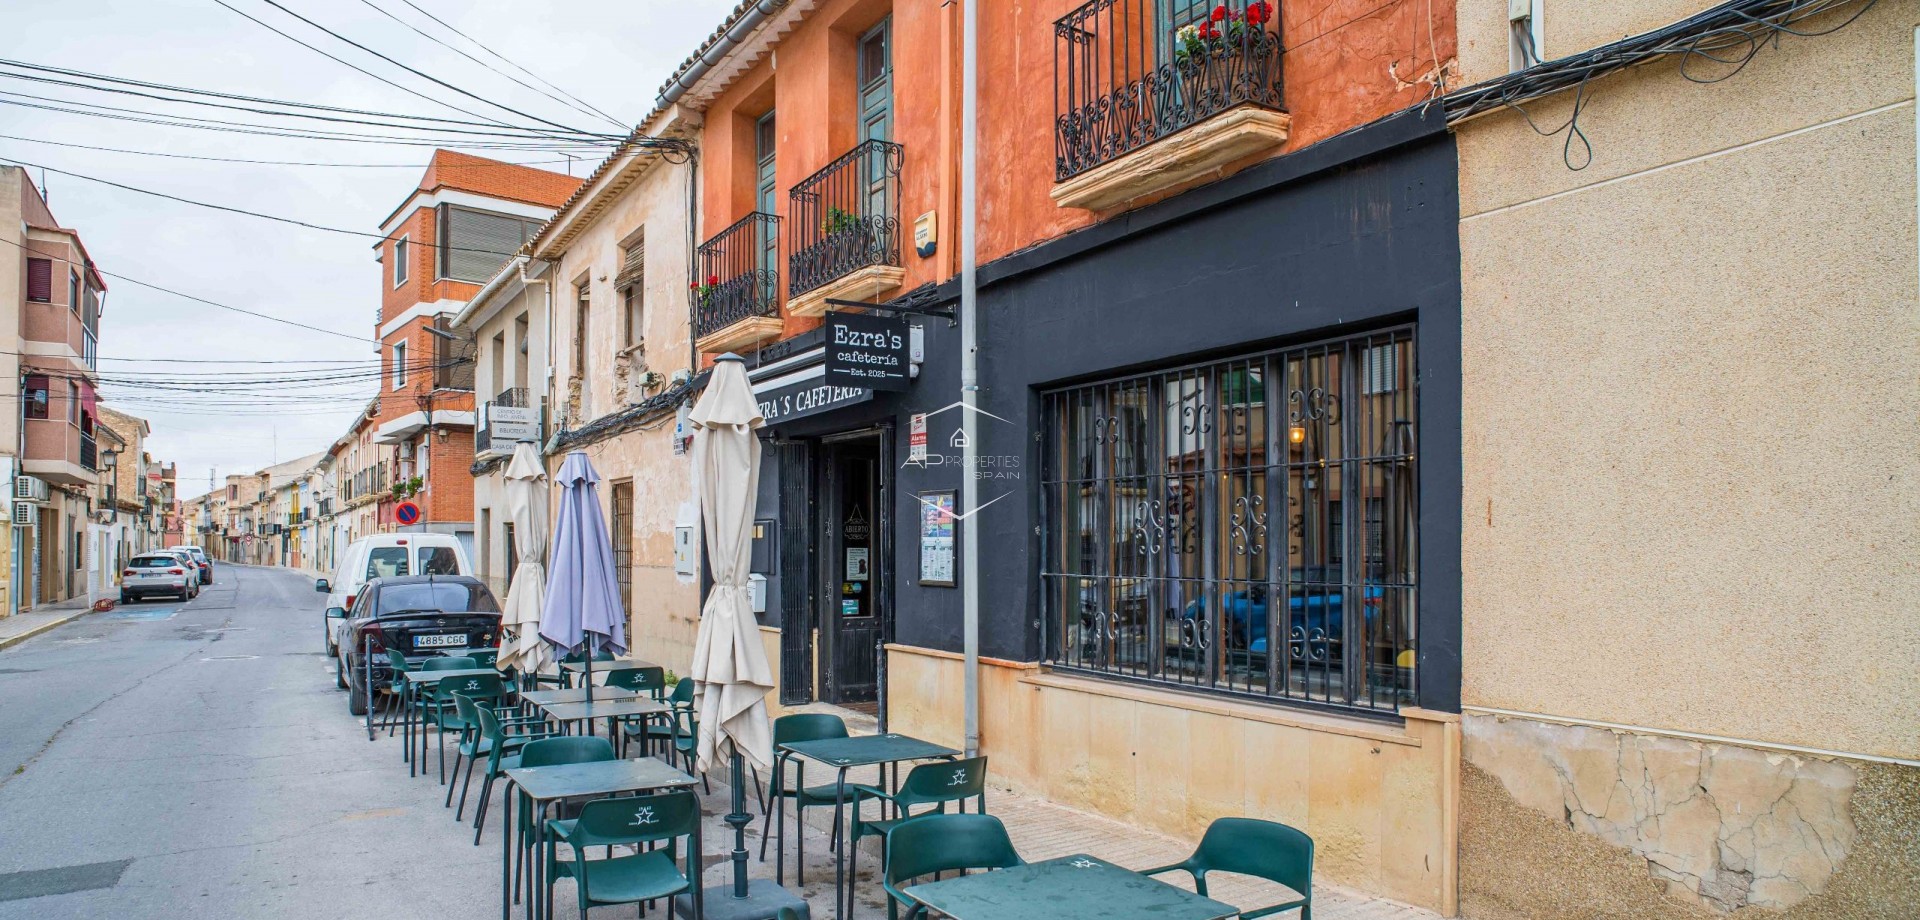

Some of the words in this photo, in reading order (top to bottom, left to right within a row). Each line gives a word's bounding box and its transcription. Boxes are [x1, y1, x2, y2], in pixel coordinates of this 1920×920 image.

[834, 324, 902, 349] Ezra's
[837, 351, 898, 365] cafetería
[851, 368, 866, 376] Est.
[845, 525, 869, 533] ABIERTO
[419, 636, 444, 645] 4885
